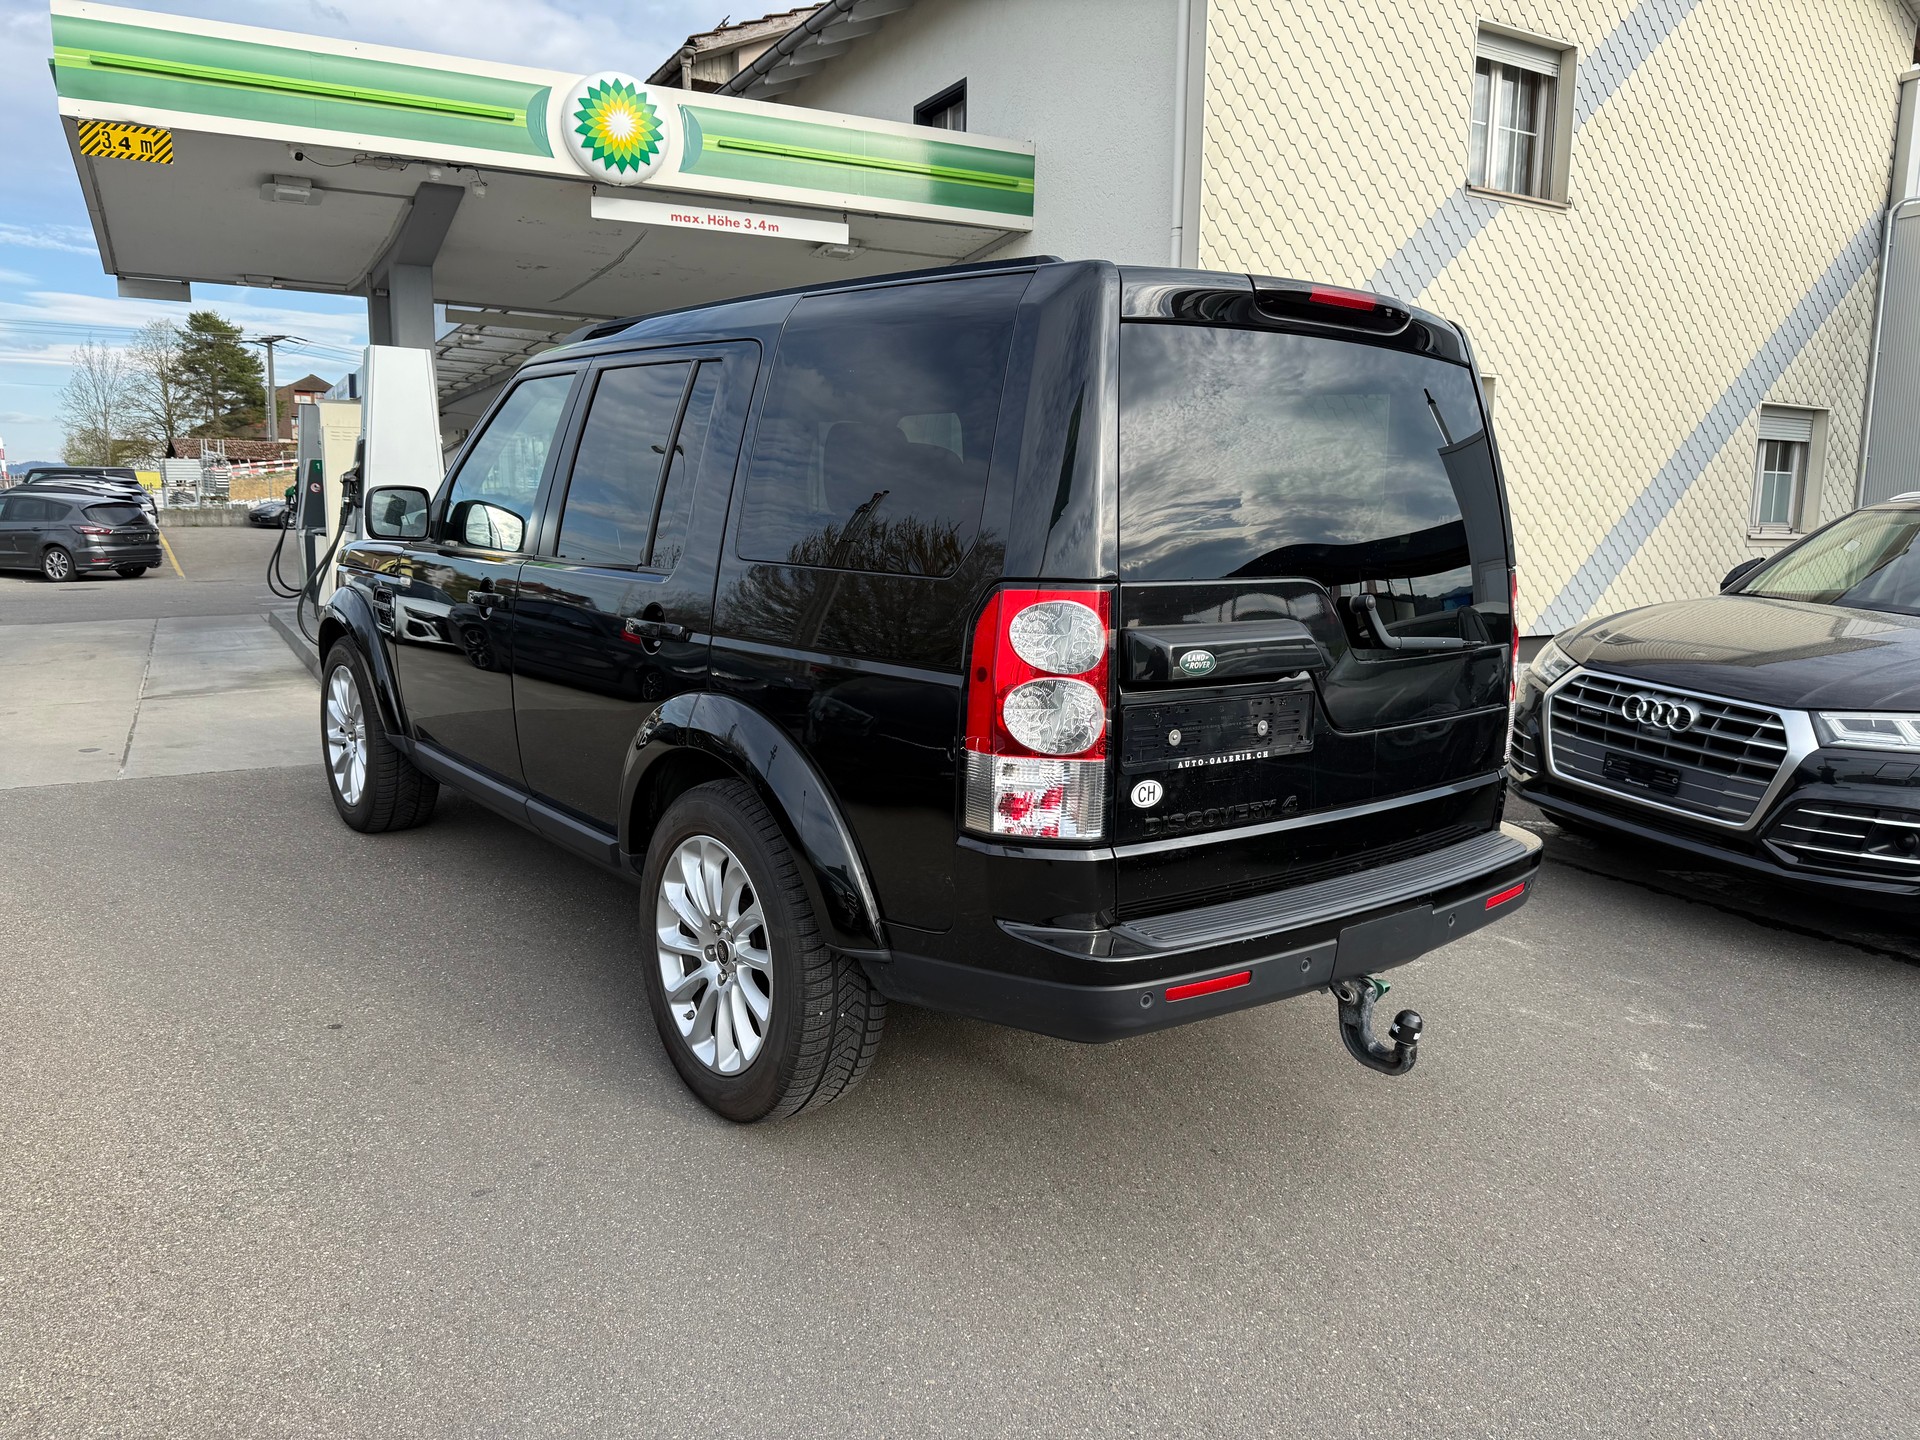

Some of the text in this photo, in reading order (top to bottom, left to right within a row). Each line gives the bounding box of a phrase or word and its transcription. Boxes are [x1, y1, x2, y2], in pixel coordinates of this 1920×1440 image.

[101, 131, 153, 154] 3.4 m
[670, 213, 704, 224] max.
[707, 214, 741, 228] Höhe
[1187, 654, 1206, 662] LAND
[1189, 661, 1211, 670] ROVER
[1177, 751, 1269, 769] AUTO-GALERIE.CH
[1137, 785, 1156, 803] CH
[1143, 795, 1298, 836] DISCOVERY 4
